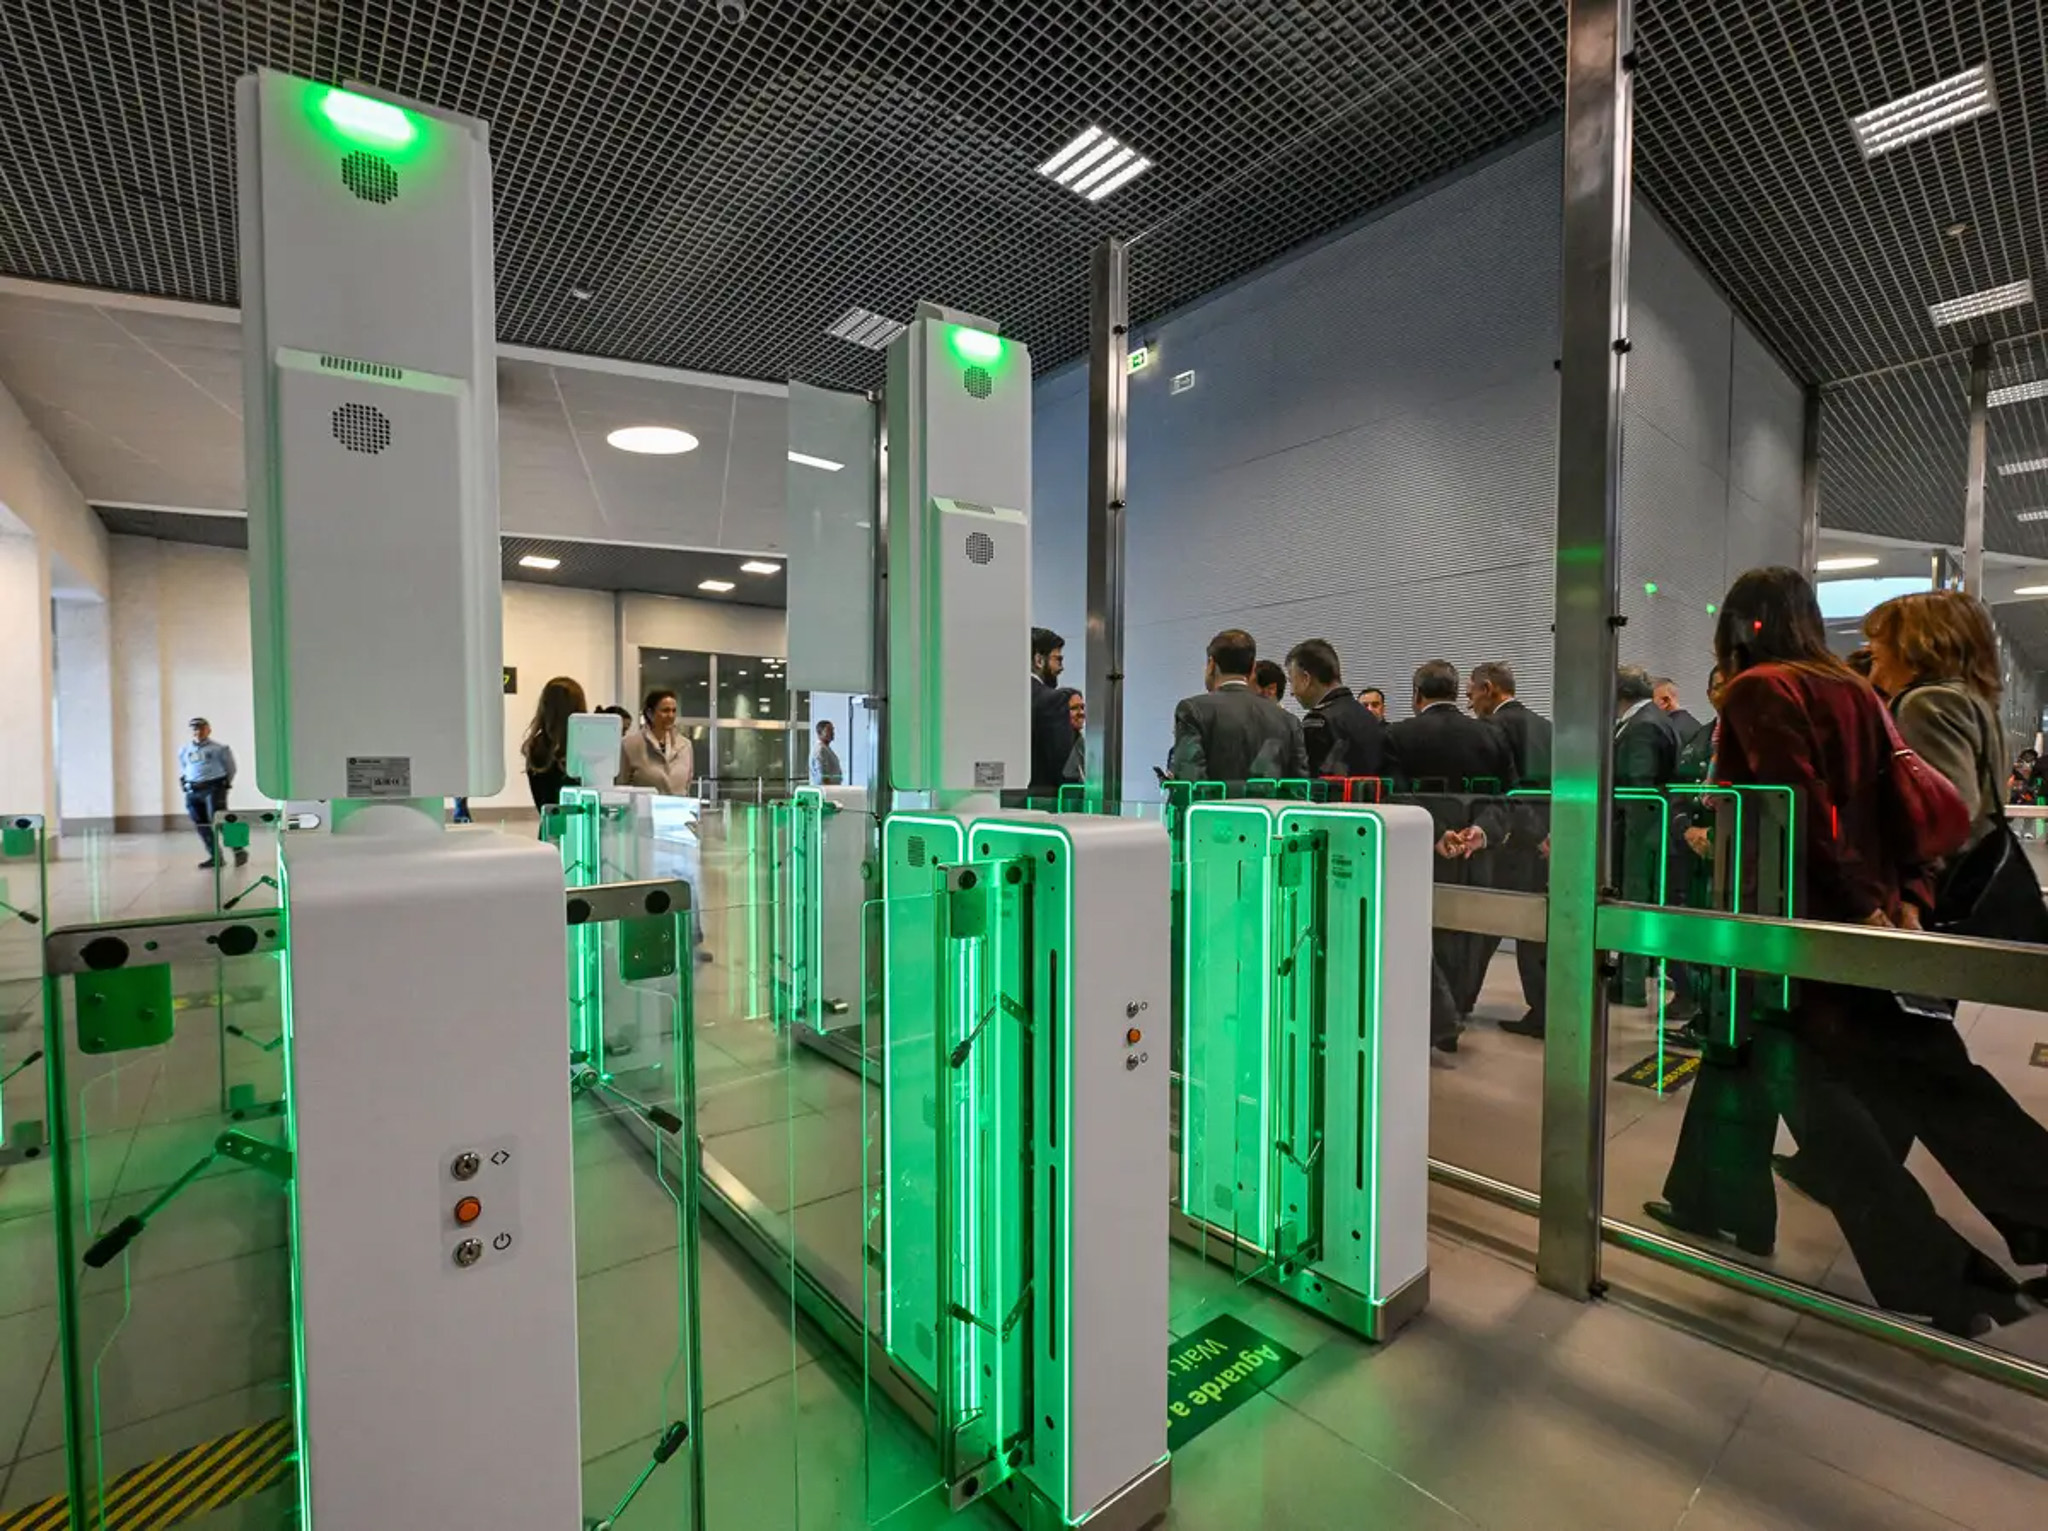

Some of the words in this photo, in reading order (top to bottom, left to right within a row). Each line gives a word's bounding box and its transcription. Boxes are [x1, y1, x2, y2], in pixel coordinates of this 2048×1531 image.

[1171, 1338, 1228, 1371] Wait
[1188, 1345, 1281, 1405] Aguarde
[1169, 1401, 1191, 1417] a
